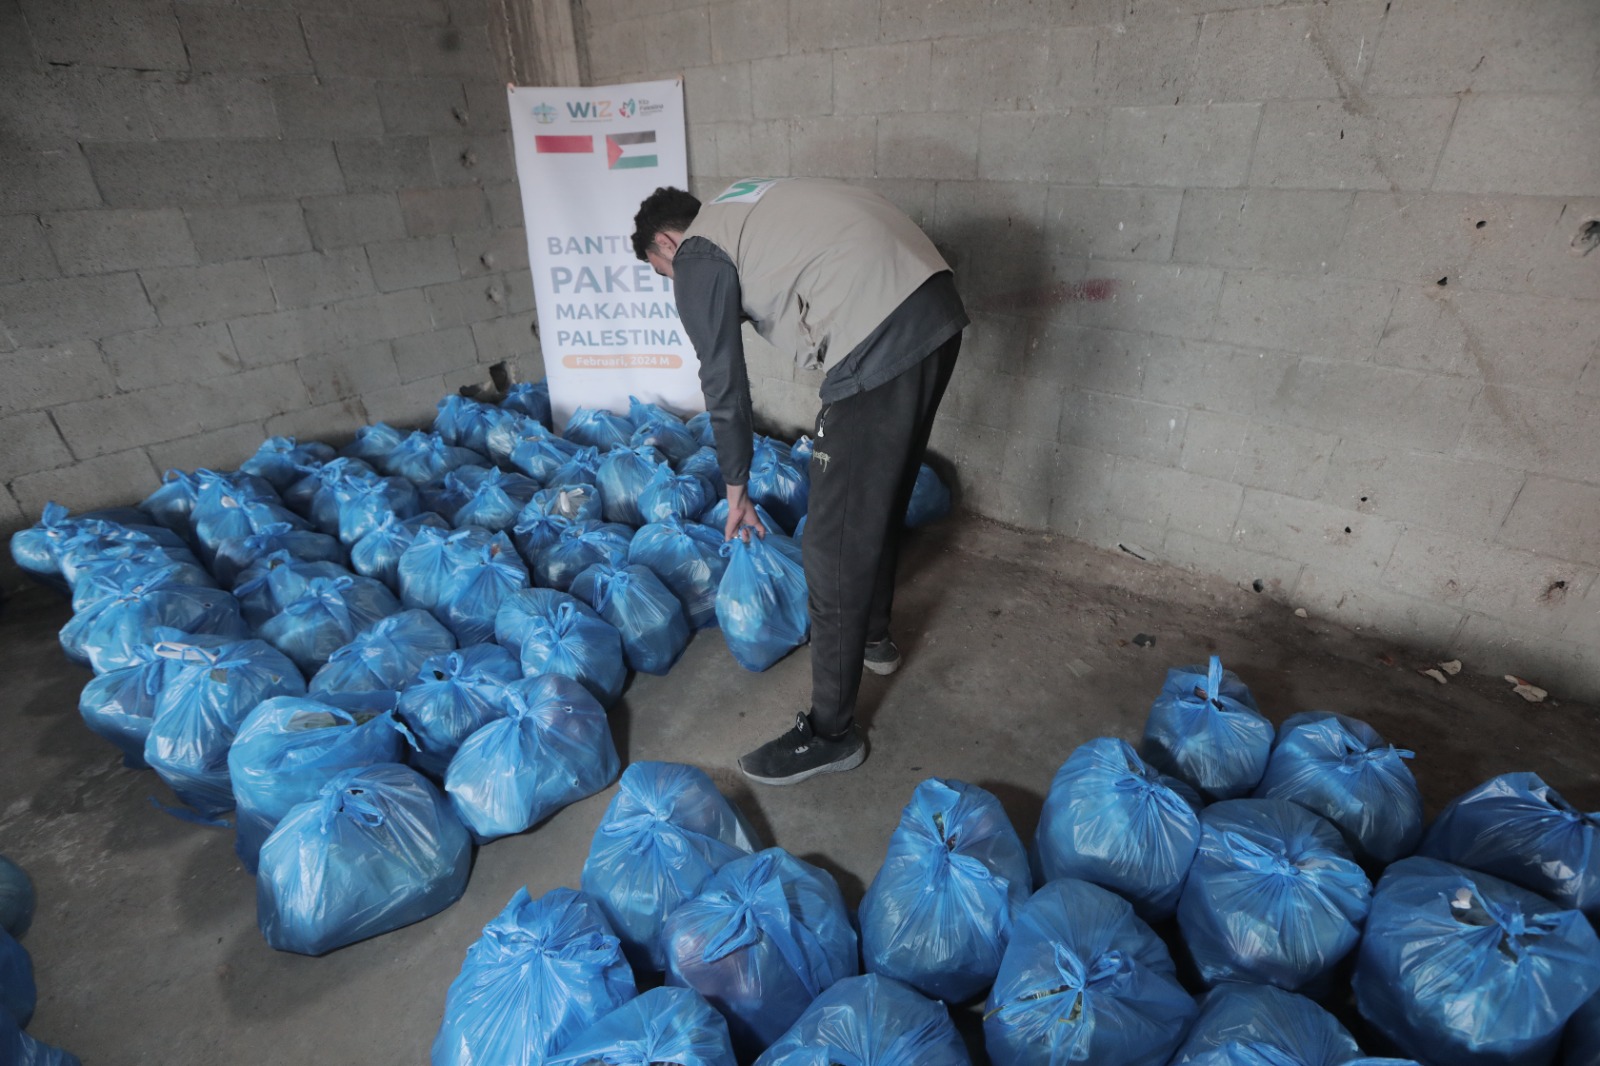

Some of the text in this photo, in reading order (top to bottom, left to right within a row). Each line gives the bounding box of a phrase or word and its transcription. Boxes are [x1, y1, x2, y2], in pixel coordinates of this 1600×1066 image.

[557, 330, 682, 347] PALESTINA
[576, 355, 670, 367] Februari, 2024 M
